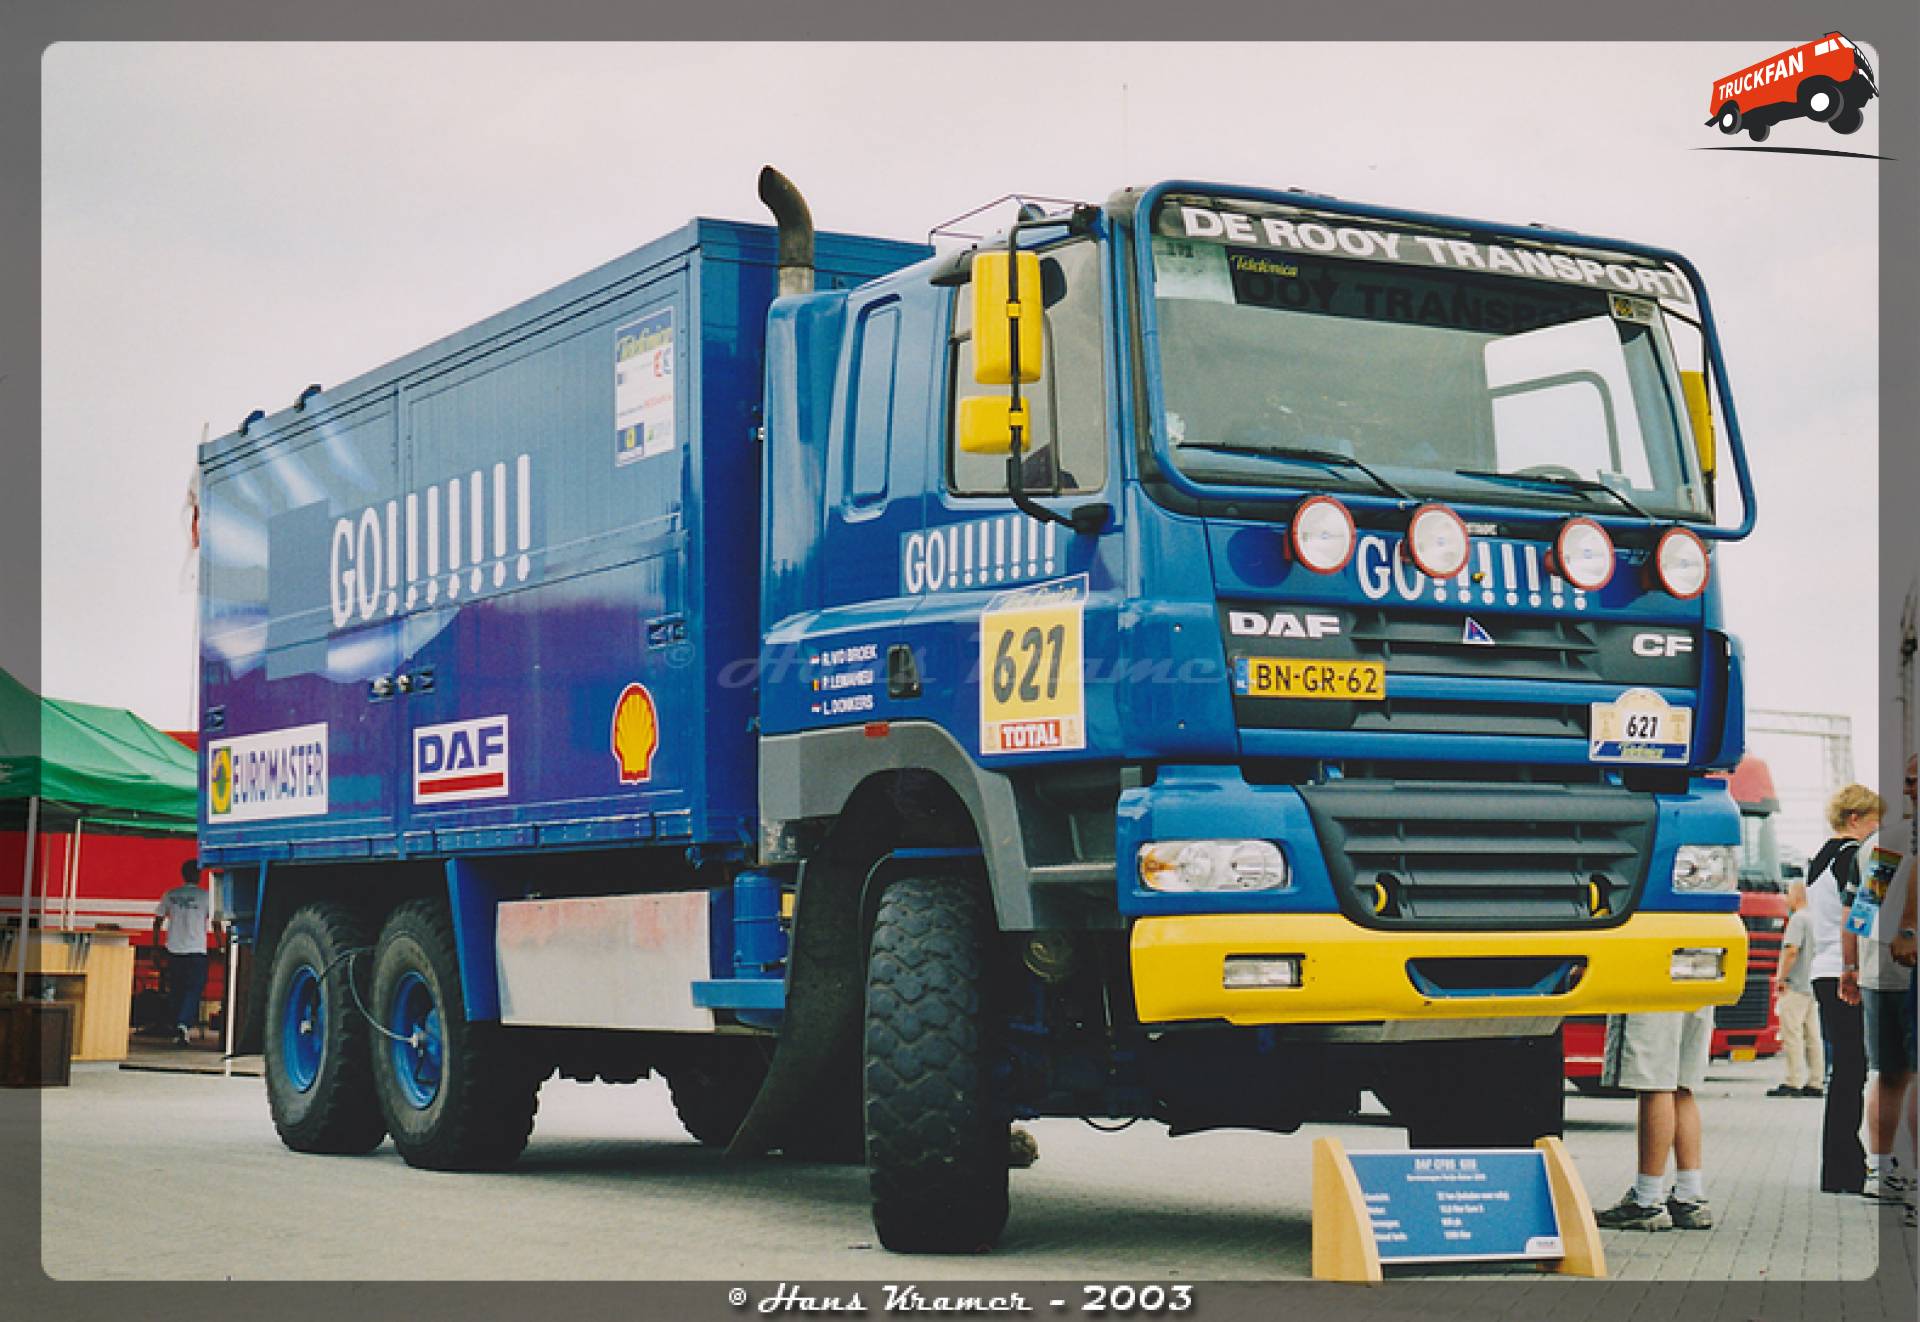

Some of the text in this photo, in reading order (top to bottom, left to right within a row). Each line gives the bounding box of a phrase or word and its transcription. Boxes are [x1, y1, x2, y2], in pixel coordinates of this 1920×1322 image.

[1181, 206, 1686, 300] DE ROOY TRANSPORT
[1229, 611, 1340, 638] DAF
[1632, 633, 1693, 657] CF
[993, 624, 1066, 705] 621
[1256, 663, 1378, 694] BN-GR-62
[1001, 723, 1061, 748] TOTAL
[1626, 714, 1658, 738] 621
[417, 725, 504, 773] DAF
[231, 741, 324, 804] EUROMASTER
